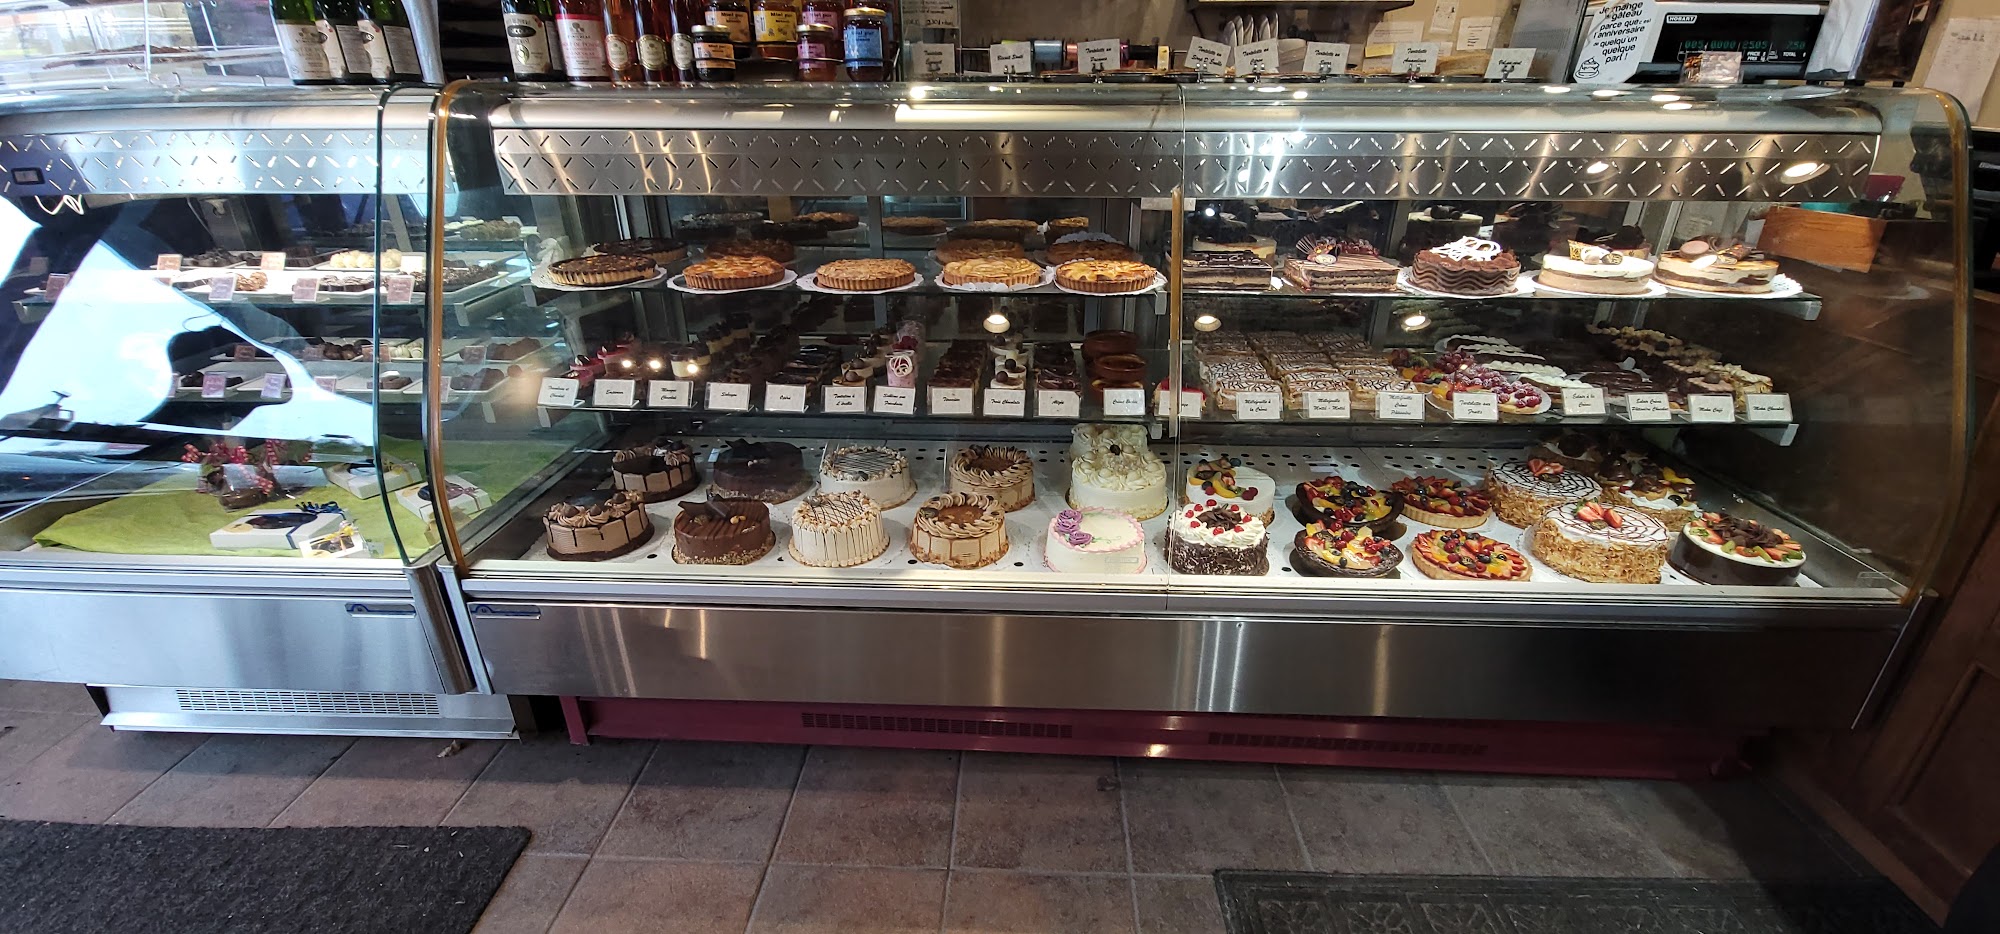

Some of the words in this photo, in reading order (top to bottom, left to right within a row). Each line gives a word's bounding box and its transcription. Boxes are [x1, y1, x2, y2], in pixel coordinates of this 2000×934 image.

[1612, 2, 1644, 12] mange
[1600, 22, 1622, 32] parce
[1625, 19, 1639, 28] que
[1602, 44, 1636, 56] quelque
[1605, 53, 1623, 64] part
